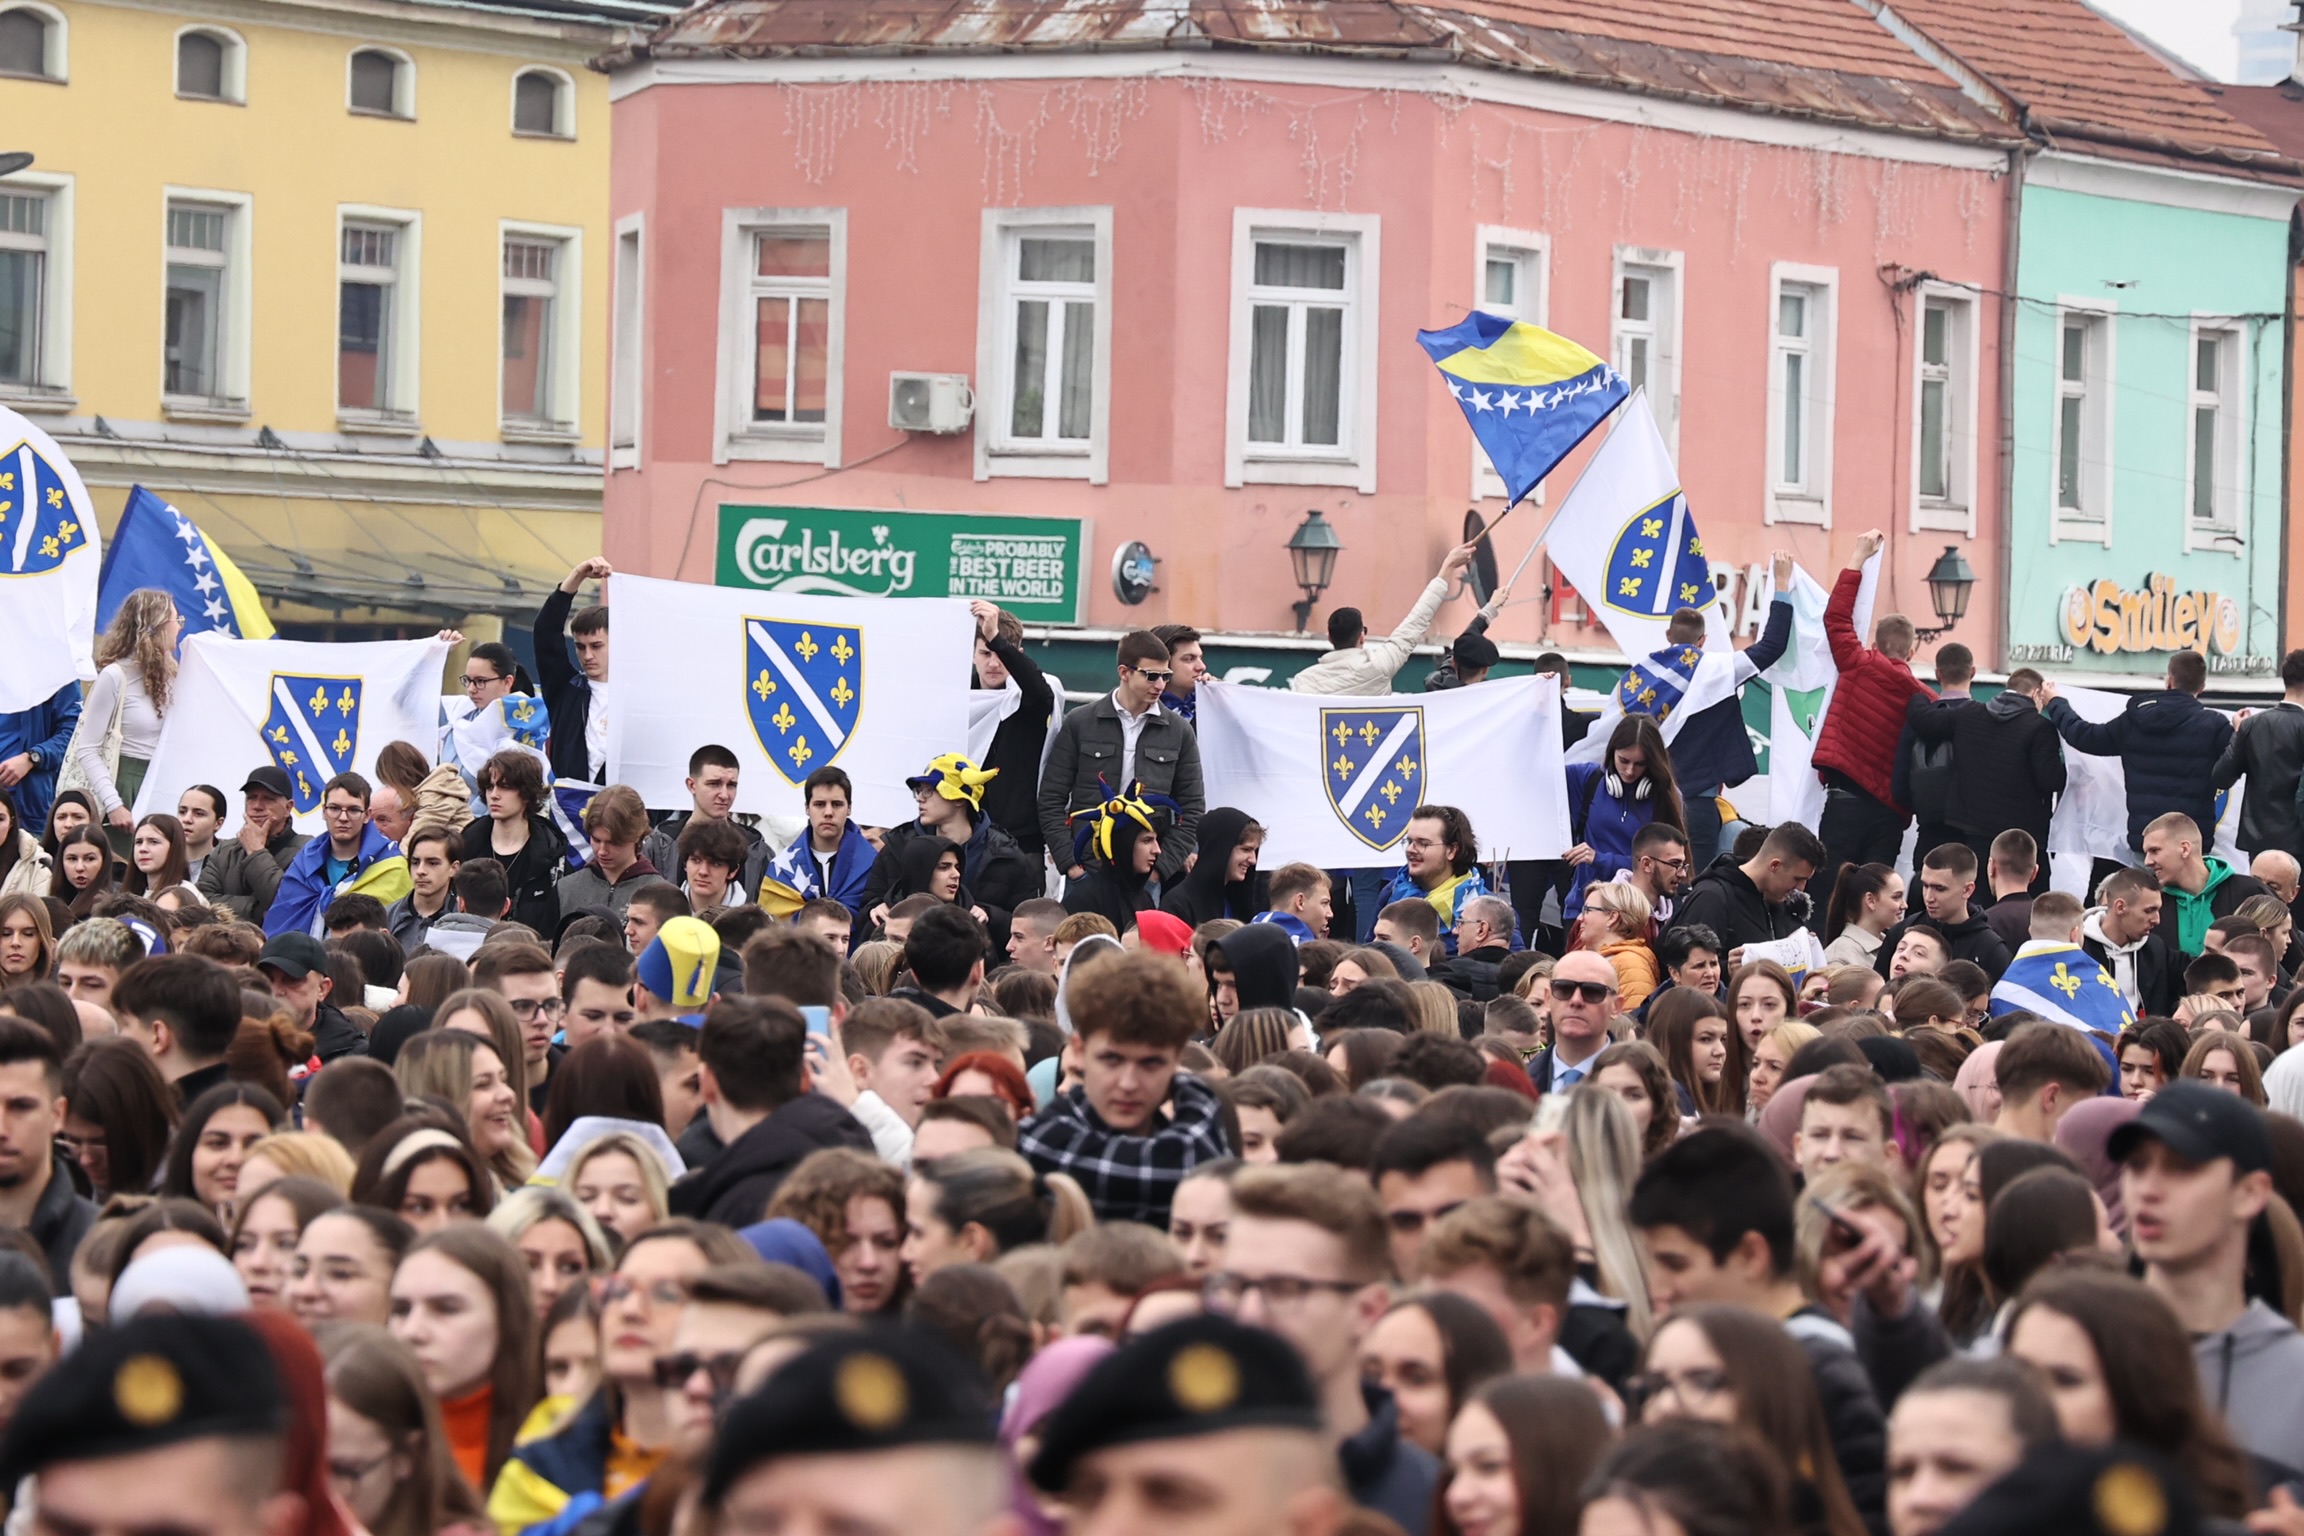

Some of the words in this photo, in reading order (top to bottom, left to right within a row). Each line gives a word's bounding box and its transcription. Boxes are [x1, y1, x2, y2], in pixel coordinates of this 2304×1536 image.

[735, 518, 917, 593] Carlsberg
[985, 541, 1065, 558] PROBABLY
[959, 556, 1011, 577] BEST
[1012, 559, 1064, 580] BEER
[949, 577, 965, 594] IN
[967, 578, 1000, 595] THE
[1001, 579, 1064, 597] WORLD
[2091, 572, 2218, 657] Smiley
